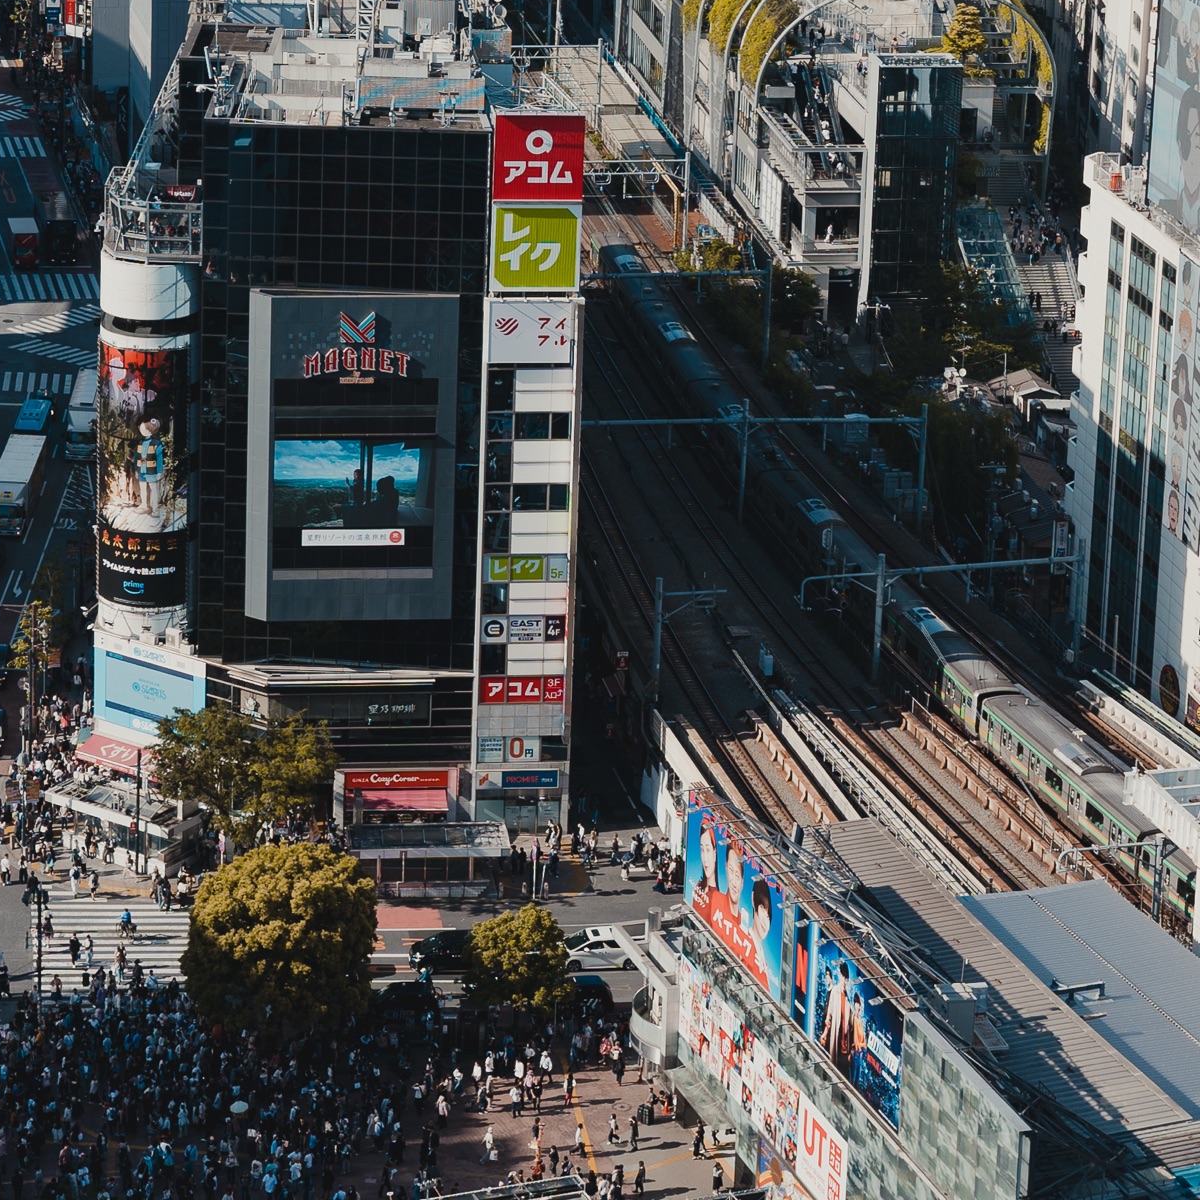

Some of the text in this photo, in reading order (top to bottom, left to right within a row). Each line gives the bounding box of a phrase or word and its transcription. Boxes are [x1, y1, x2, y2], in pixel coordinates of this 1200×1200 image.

[503, 161, 573, 185] アコム
[303, 346, 412, 379] MAGNET
[101, 529, 178, 552] 鬼太郎誕生
[493, 558, 564, 580] レイク 5F
[122, 580, 145, 589] prime
[510, 619, 542, 628] EAST
[547, 625, 561, 636] 4F
[488, 678, 561, 697] アコム 3F
[544, 691, 558, 700] 入口
[509, 737, 535, 759] 0円
[506, 775, 540, 784] PROMISE
[794, 942, 809, 996] N
[803, 1108, 828, 1168] UT
